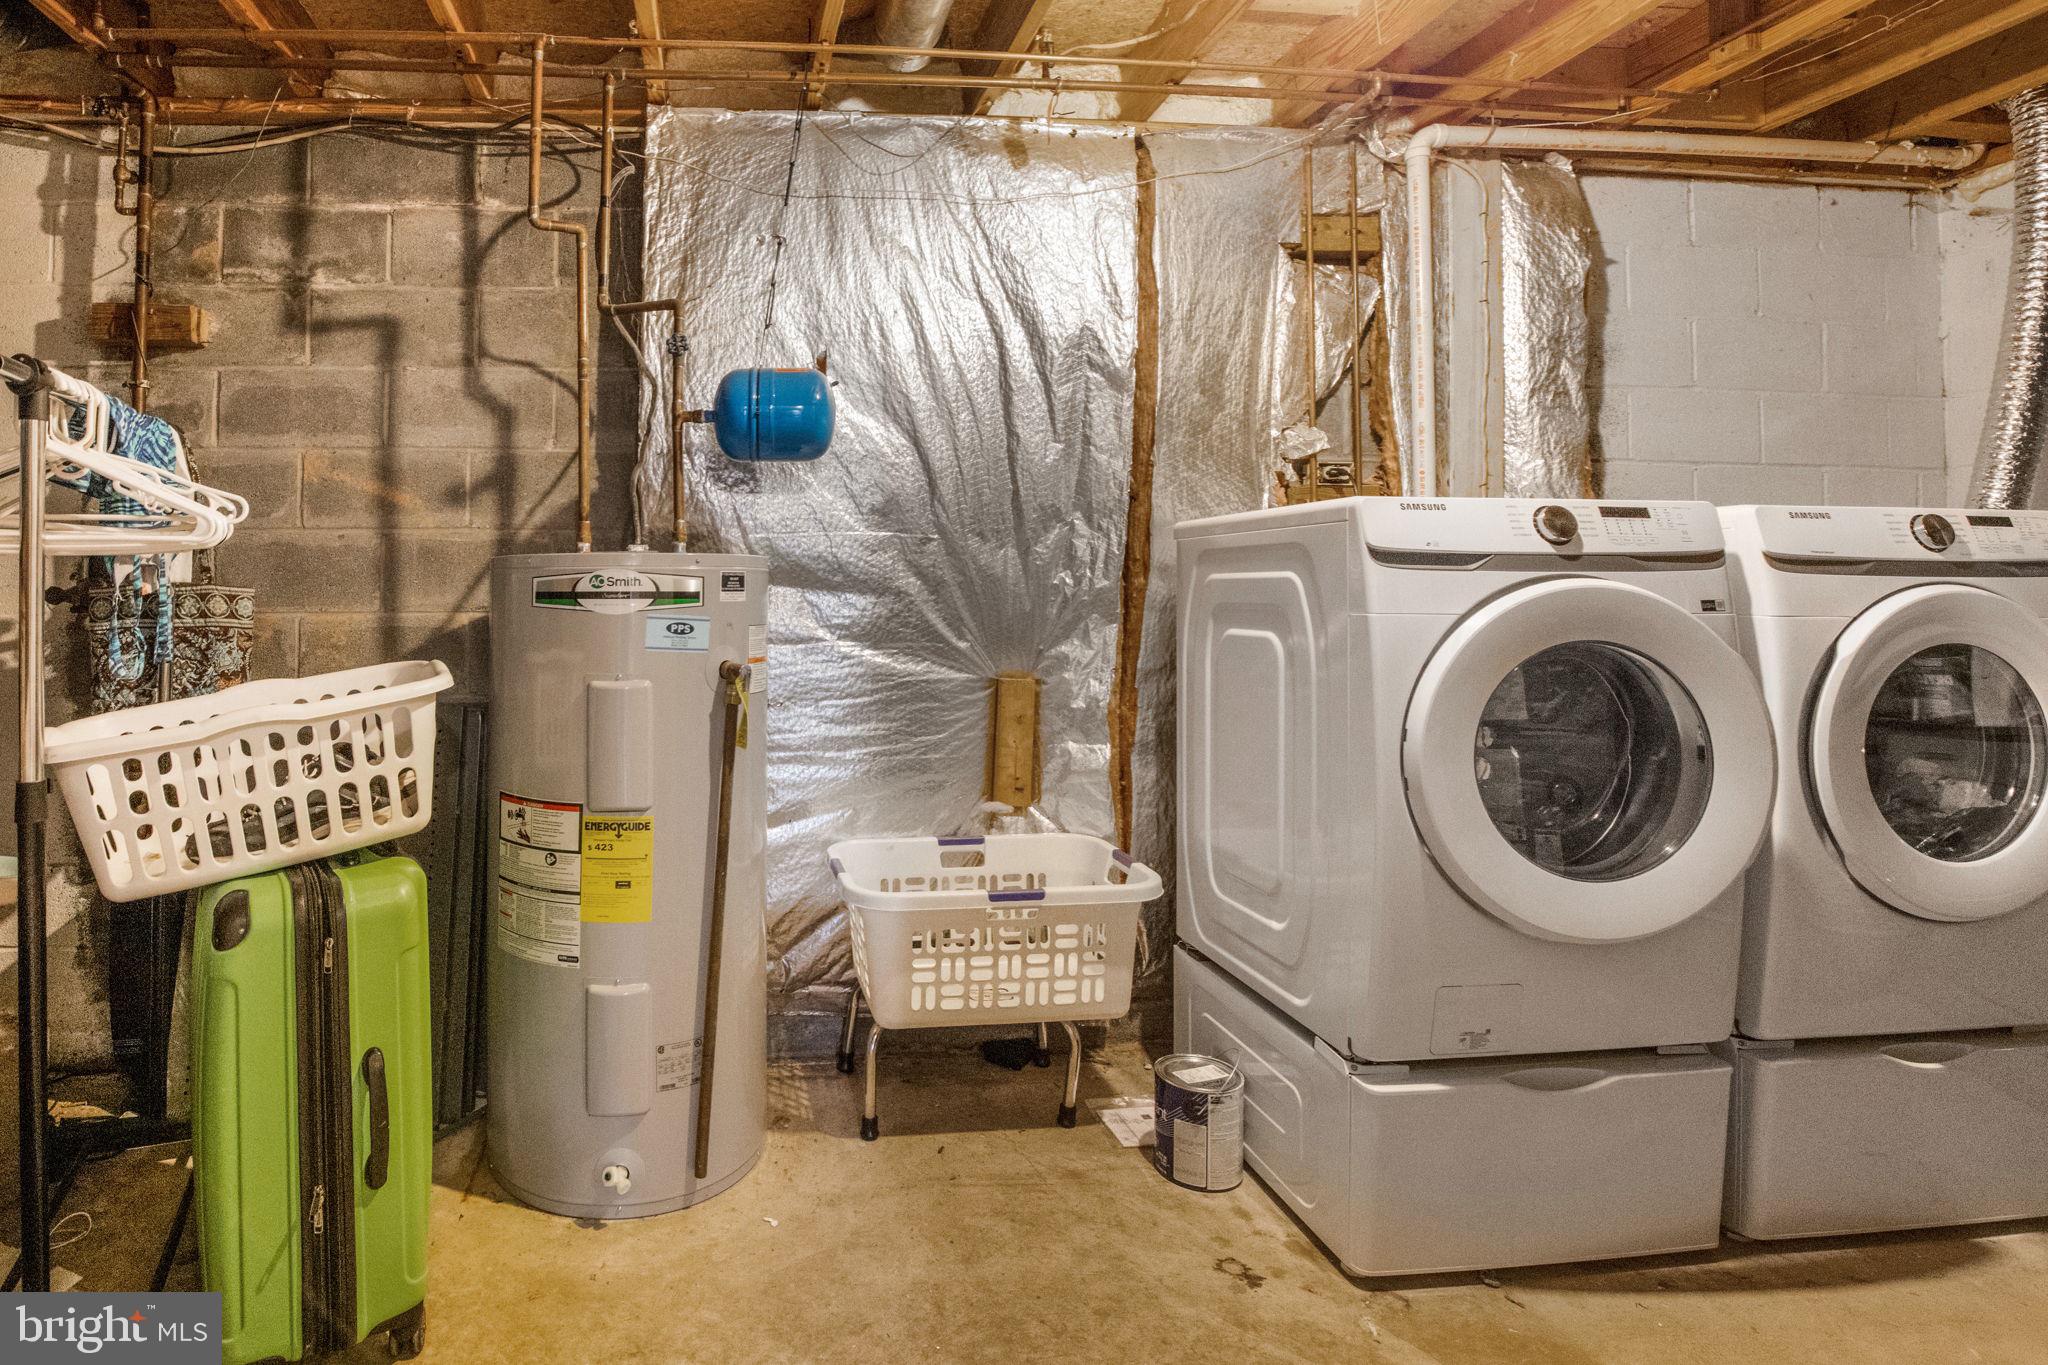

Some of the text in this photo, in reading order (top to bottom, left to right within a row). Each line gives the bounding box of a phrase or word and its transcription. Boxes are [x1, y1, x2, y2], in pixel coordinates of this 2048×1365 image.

[1400, 502, 1447, 511] SAMSUNG
[1788, 511, 1832, 520] SAMSUNG
[670, 624, 691, 633] PPS
[584, 821, 651, 832] ENERGYGUIDE
